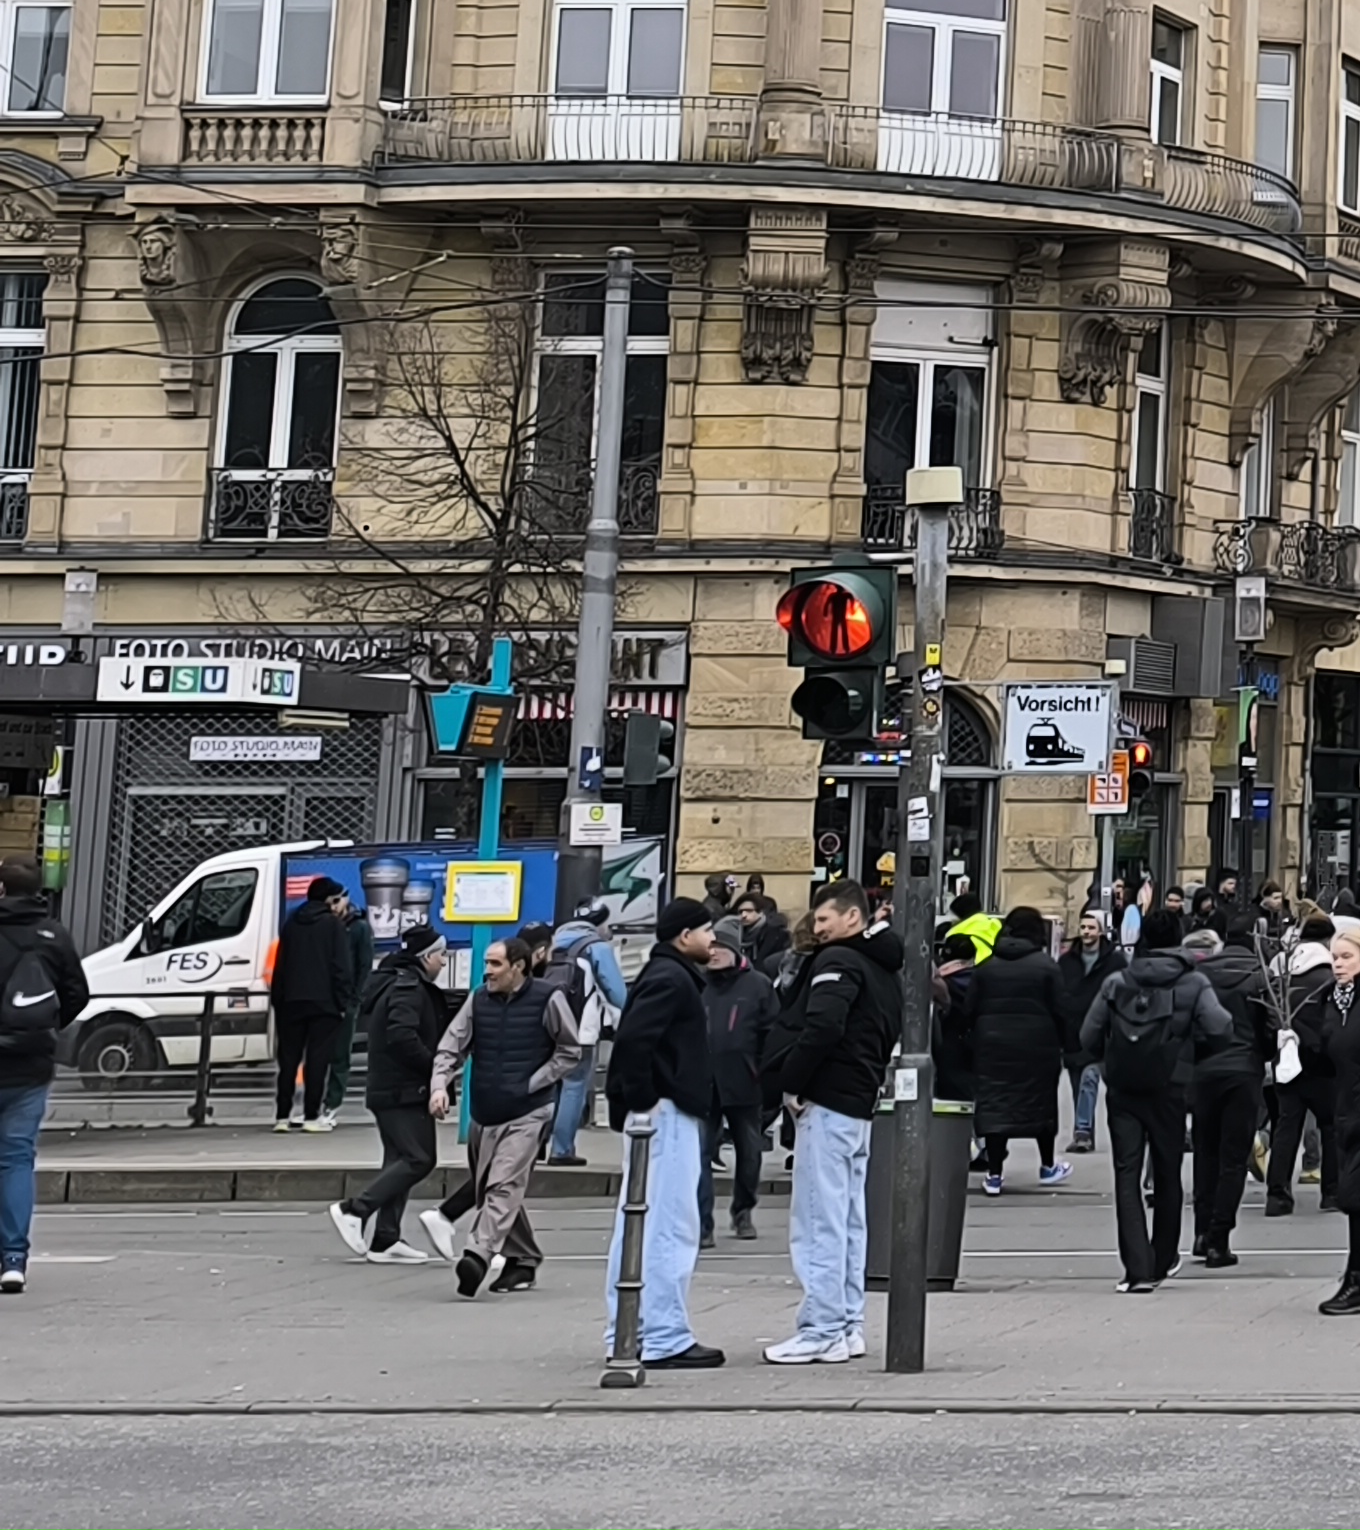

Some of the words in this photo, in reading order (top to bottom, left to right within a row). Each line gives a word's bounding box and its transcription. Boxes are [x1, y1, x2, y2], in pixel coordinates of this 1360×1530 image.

[115, 639, 190, 659] FOTO
[314, 639, 393, 663] MAIN
[165, 951, 209, 971] FES
